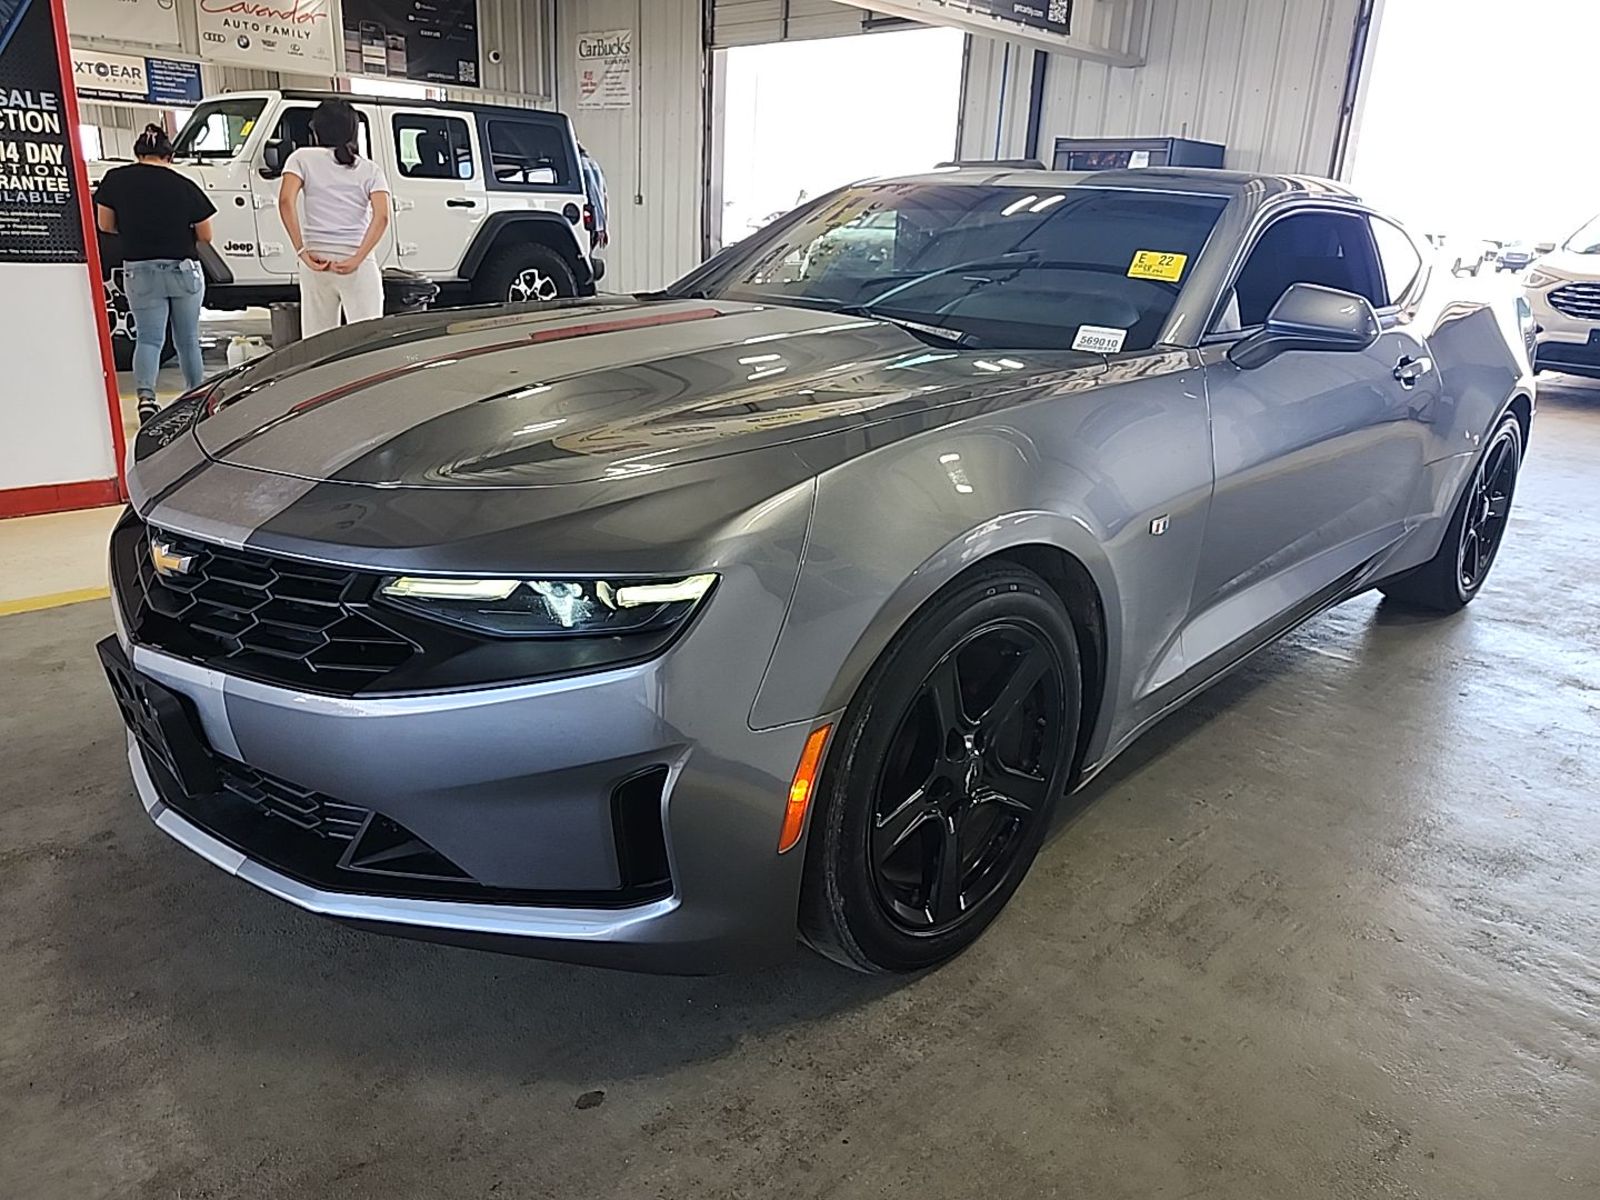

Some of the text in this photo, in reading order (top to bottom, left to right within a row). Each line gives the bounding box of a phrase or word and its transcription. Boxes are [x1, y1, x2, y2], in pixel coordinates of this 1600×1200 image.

[223, 18, 311, 40] AUTO FAMILY
[579, 37, 631, 57] CarBucks
[24, 142, 64, 165] DAY
[224, 241, 254, 252] Jeep
[1158, 255, 1175, 266] 22
[1080, 336, 1118, 348] 569010
